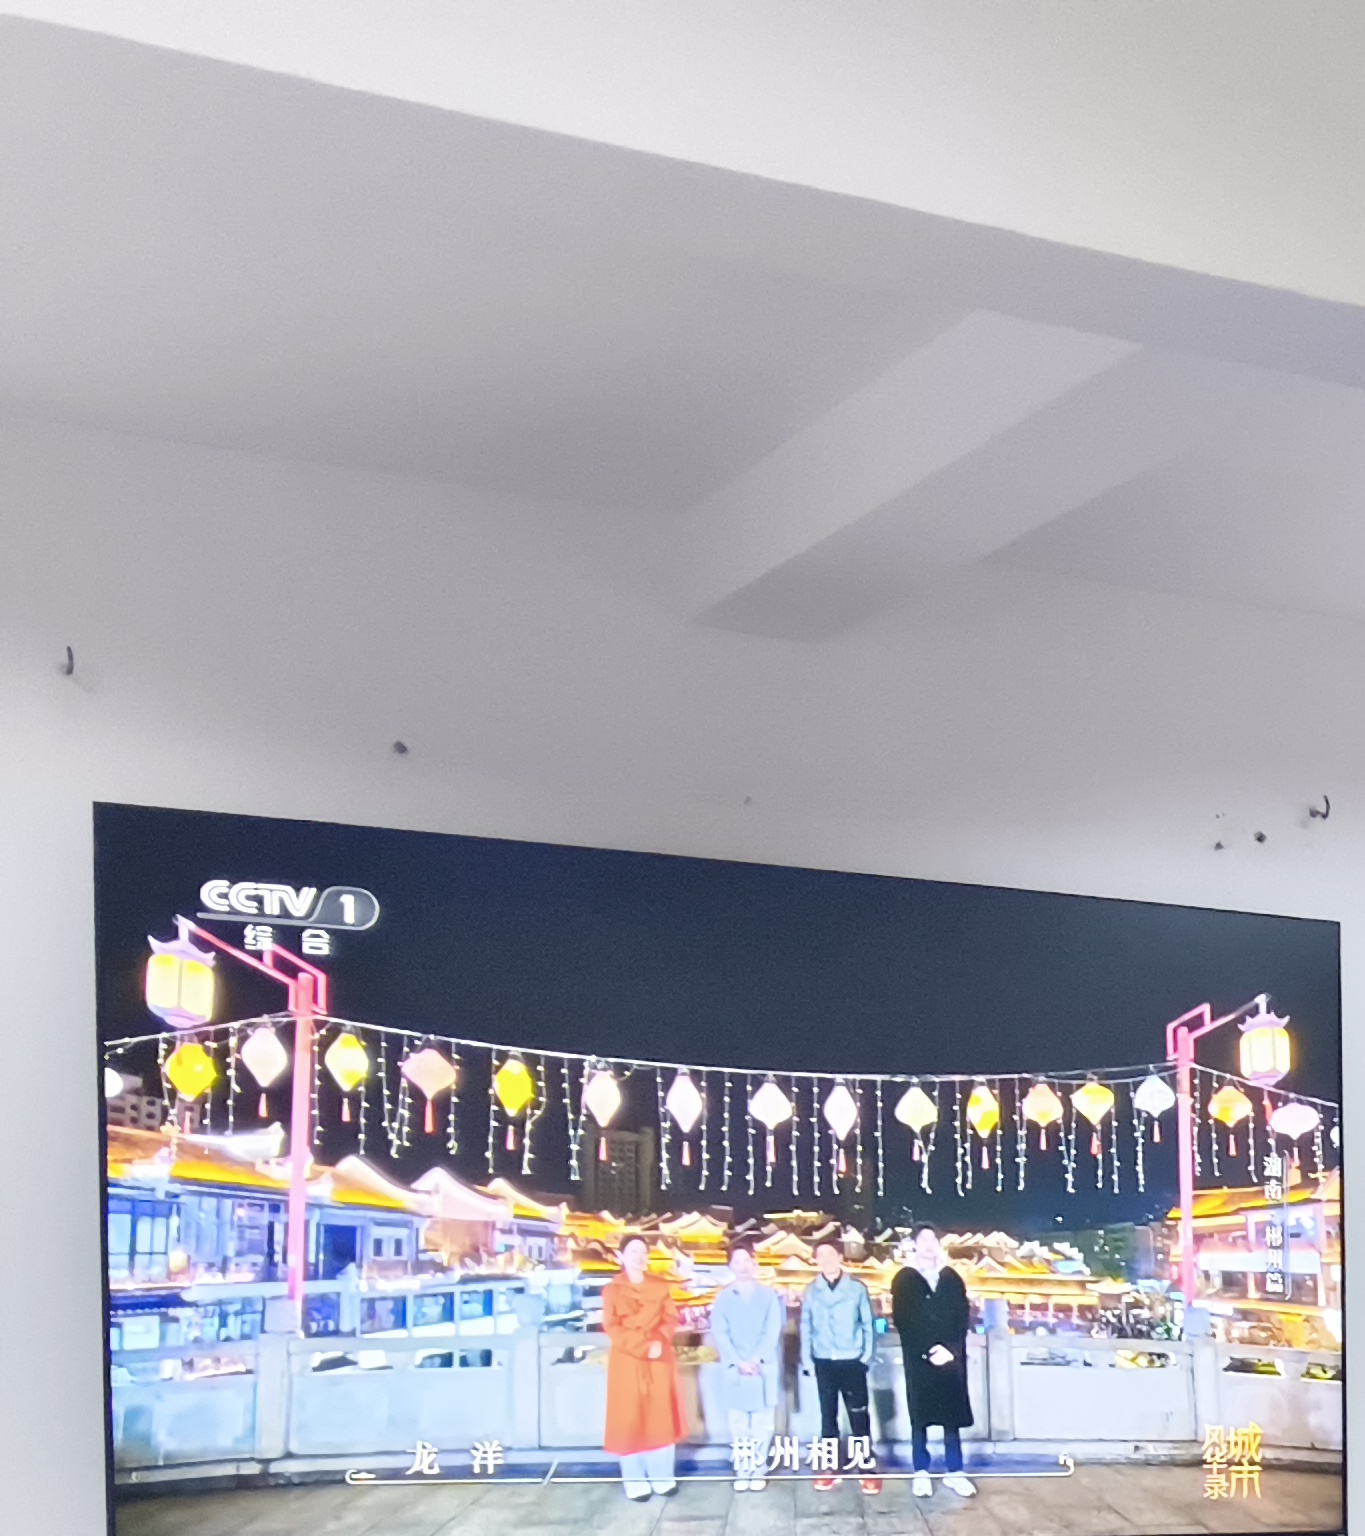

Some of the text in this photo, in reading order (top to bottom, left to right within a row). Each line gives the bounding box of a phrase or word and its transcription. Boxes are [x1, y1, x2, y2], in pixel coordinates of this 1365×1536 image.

[200, 879, 355, 924] CCTV 1
[243, 923, 331, 955] 综合
[405, 1436, 877, 1475] 龙洋 郴州相见
